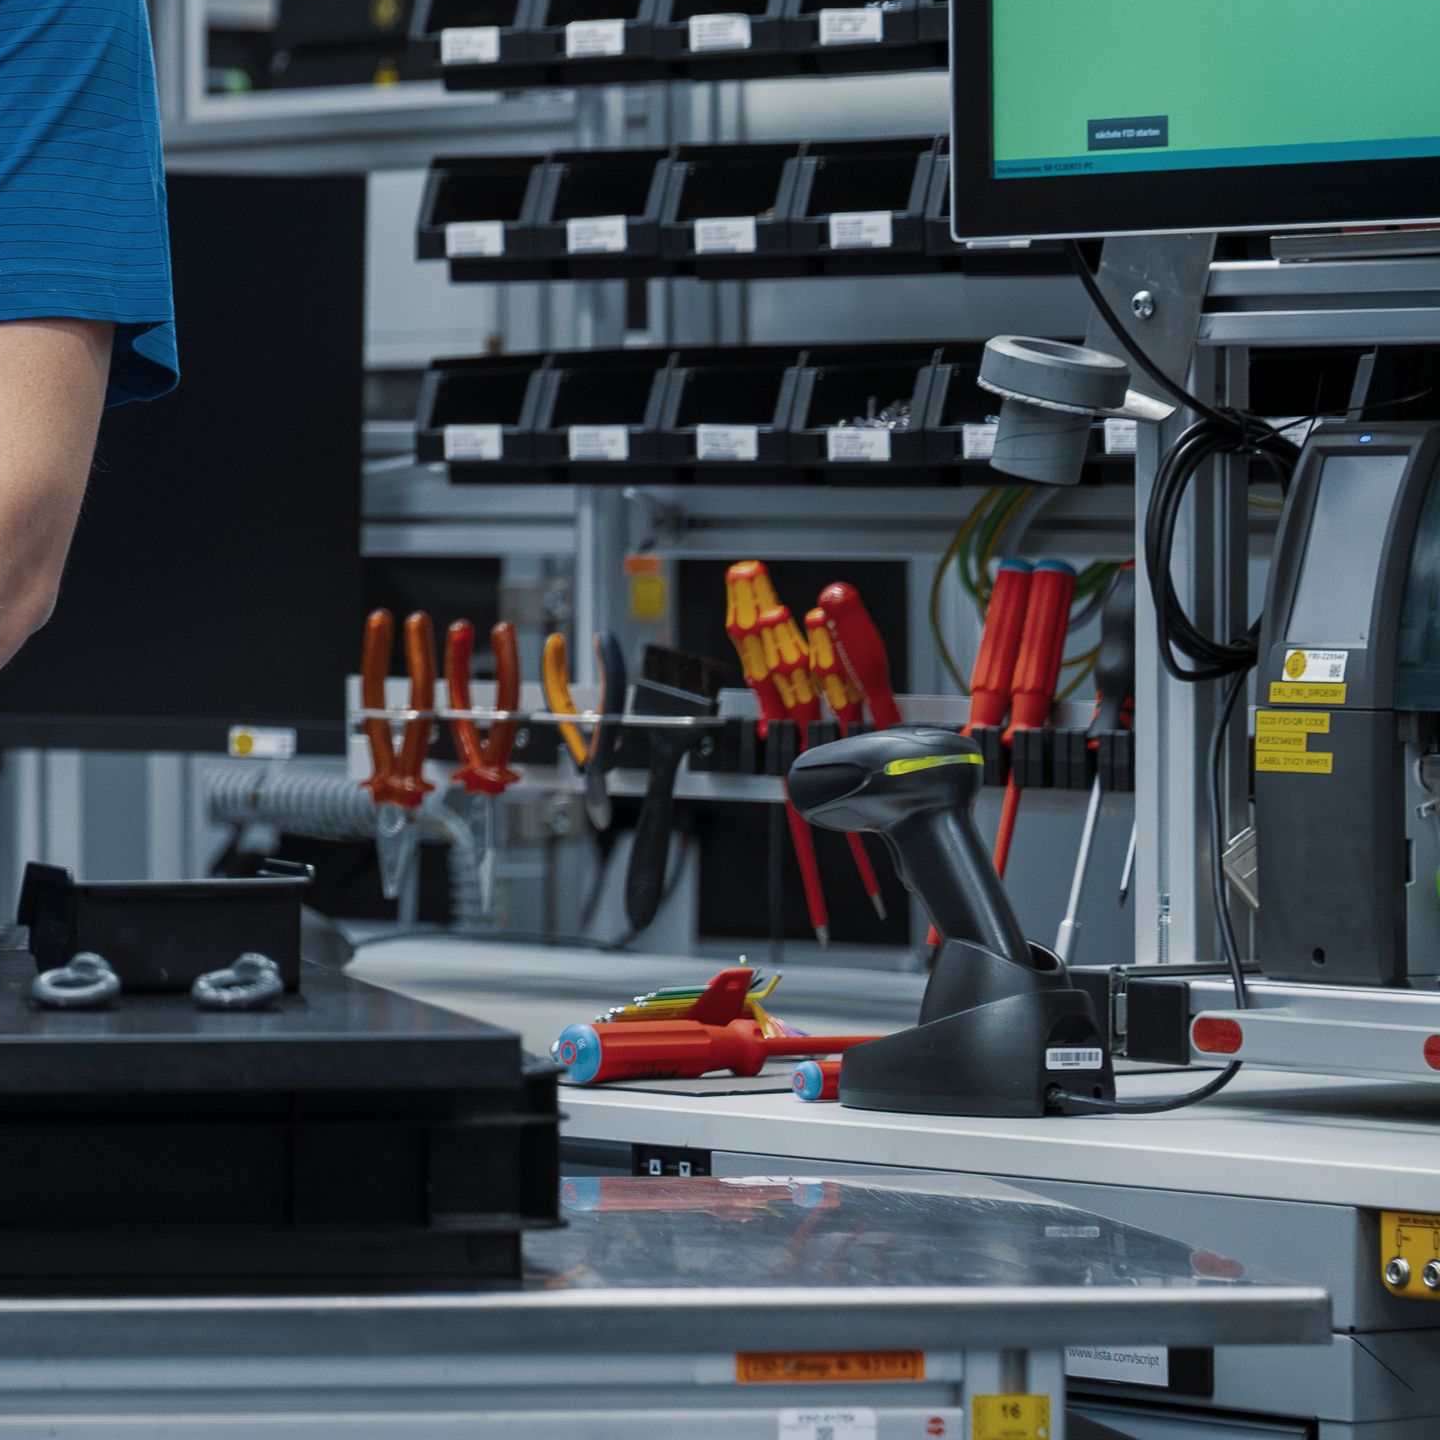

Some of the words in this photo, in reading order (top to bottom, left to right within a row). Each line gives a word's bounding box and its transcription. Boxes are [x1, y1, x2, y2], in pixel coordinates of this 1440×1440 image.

[1305, 718, 1325, 727] CODE
[1259, 756, 1281, 765] LABEL
[1305, 758, 1329, 767] WHITE
[1067, 1348, 1160, 1368] www.lista.com/script
